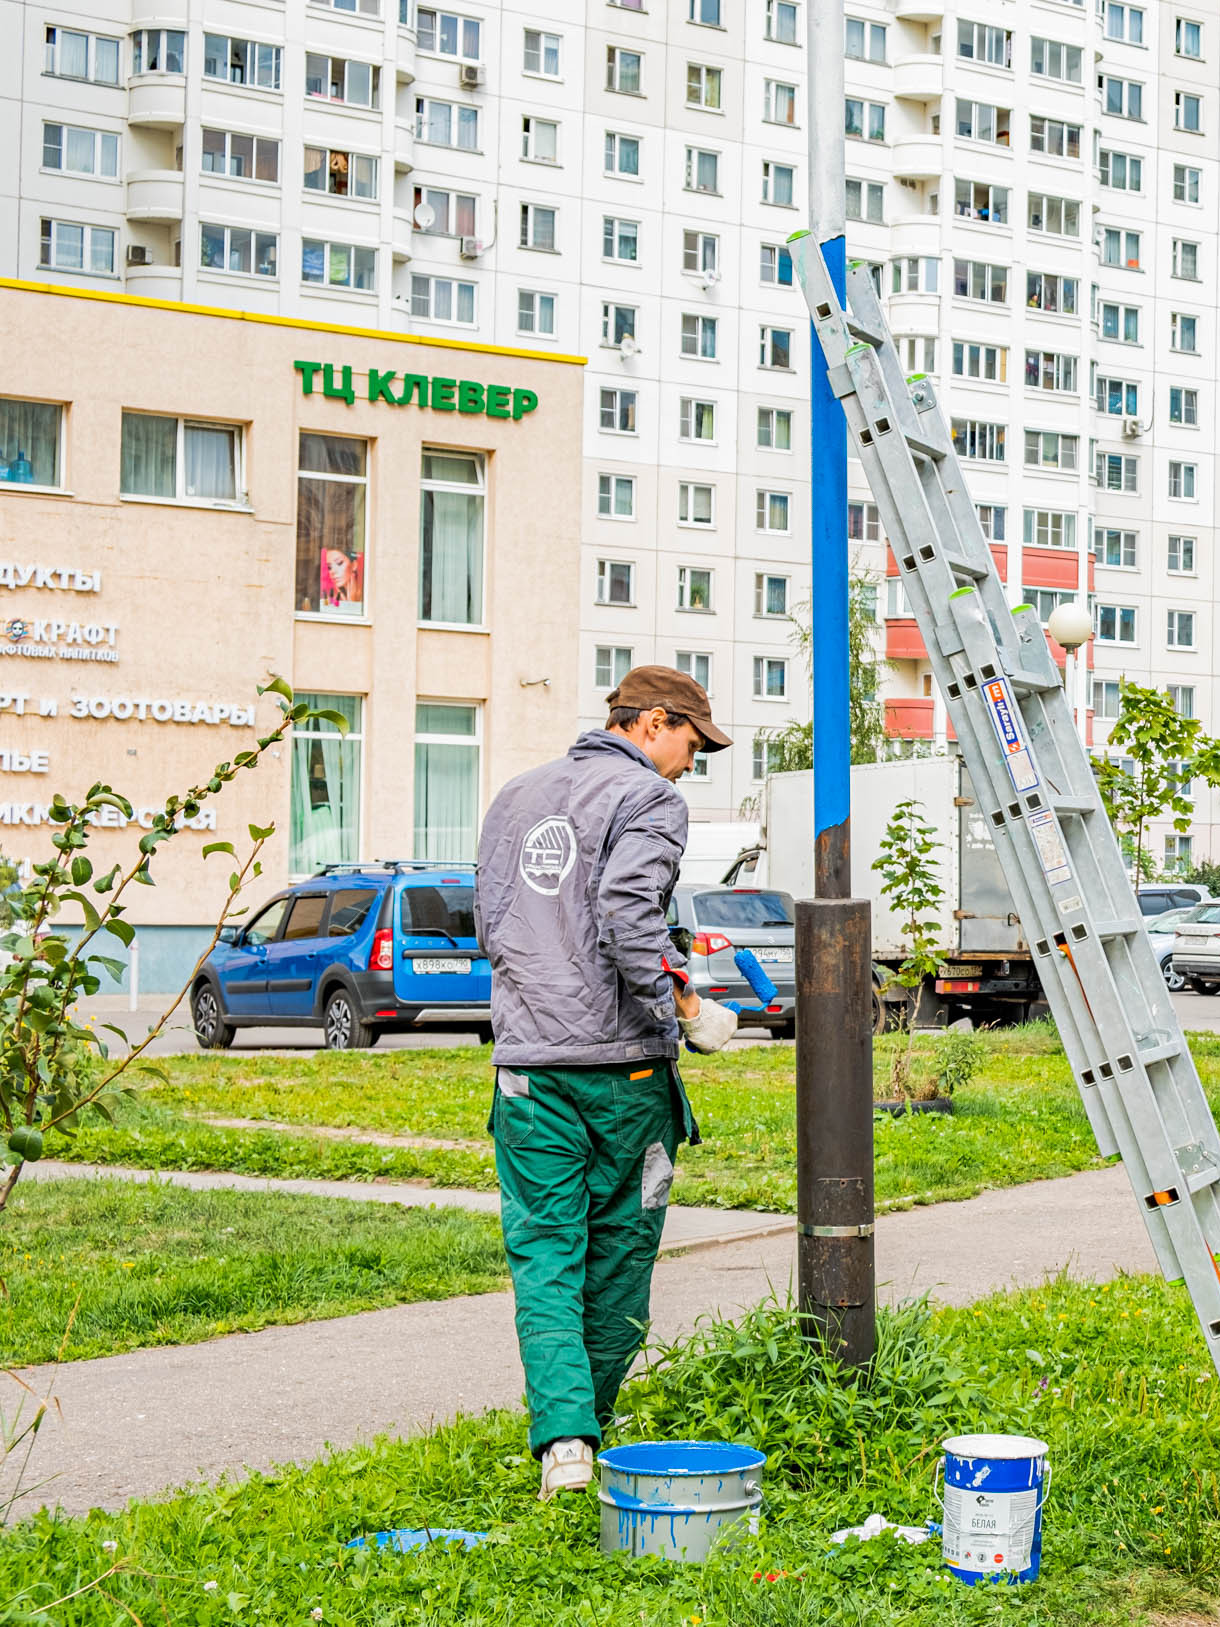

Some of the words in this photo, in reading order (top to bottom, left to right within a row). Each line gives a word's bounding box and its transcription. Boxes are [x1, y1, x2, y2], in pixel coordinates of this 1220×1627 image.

[294, 360, 355, 405] ТЦ
[368, 368, 539, 420] КЛЕВЕР
[33, 620, 119, 646] КРАФТ
[71, 696, 256, 727] ЗООТОВАРЫ
[971, 1518, 997, 1529] БЕЛАЯ
